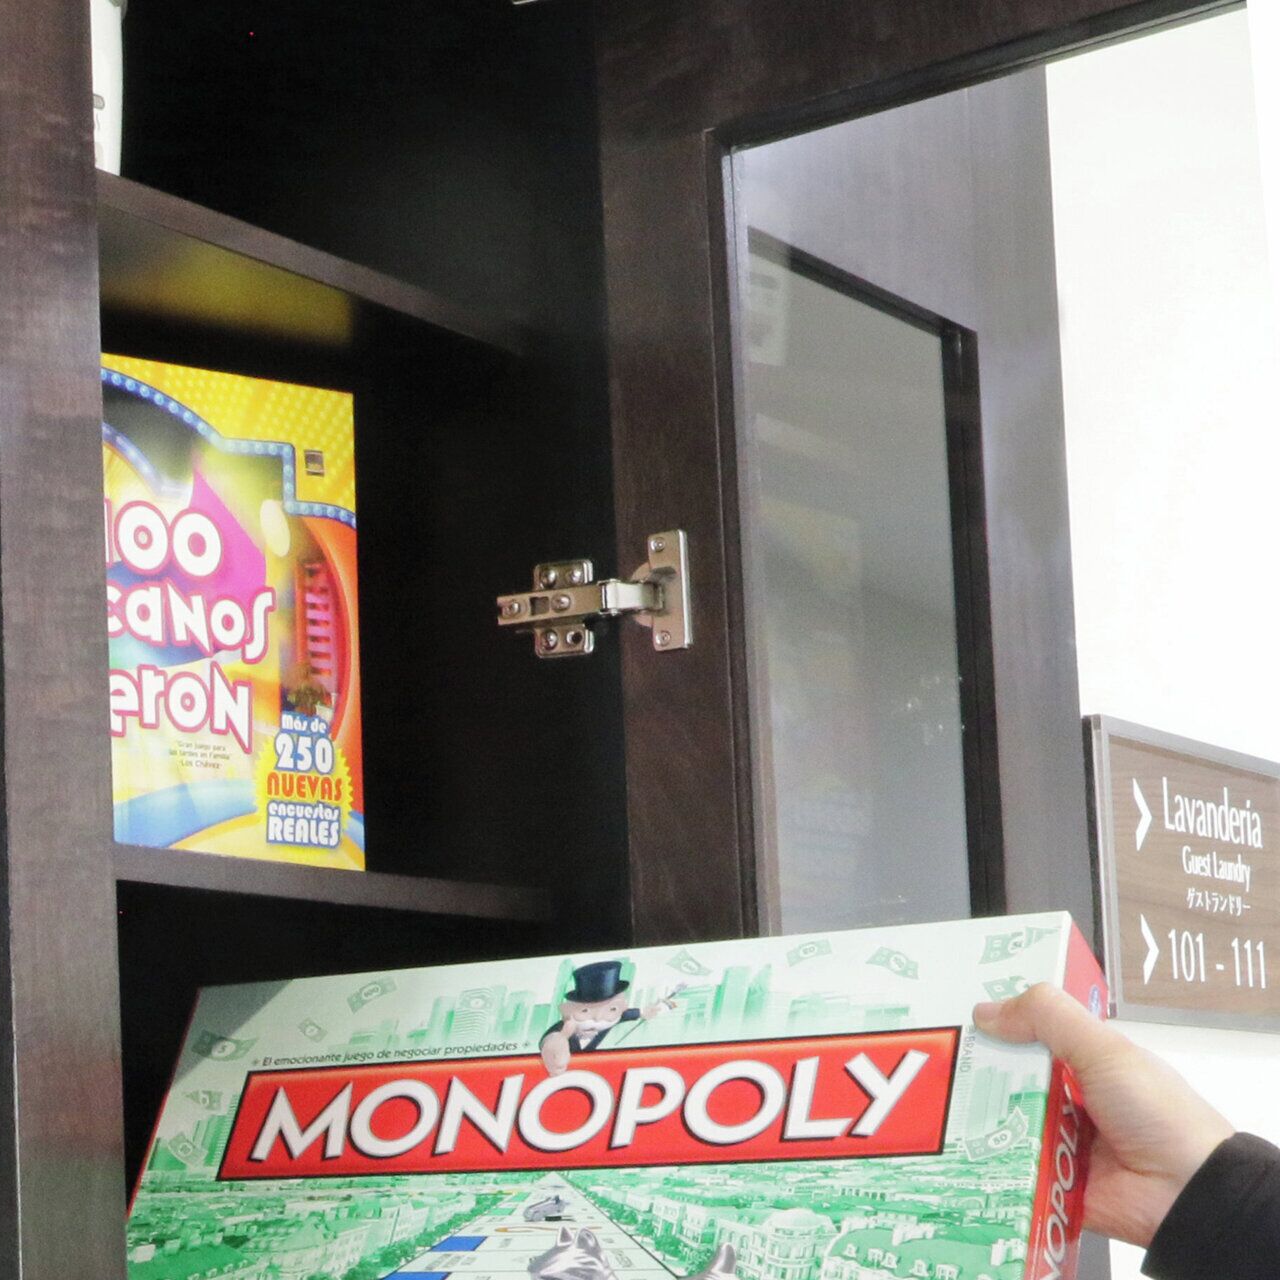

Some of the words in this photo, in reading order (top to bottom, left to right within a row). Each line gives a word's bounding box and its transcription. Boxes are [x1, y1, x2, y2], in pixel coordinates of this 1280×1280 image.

[275, 734, 333, 774] 250
[268, 818, 339, 846] REALES
[1162, 776, 1263, 849] Lavanderia
[1182, 845, 1212, 877] Guest
[1213, 851, 1251, 892] Laundry
[1186, 888, 1251, 916] ゲストランドリー
[1168, 929, 1206, 983] 101
[1231, 937, 1266, 989] 111
[262, 1056, 272, 1067] El
[274, 1053, 341, 1066] emocionante
[342, 1050, 375, 1063] juego
[376, 1048, 391, 1059] de
[394, 1046, 442, 1061] negociar
[444, 1041, 519, 1056] propiedades
[249, 1049, 931, 1162] MONOPOLY
